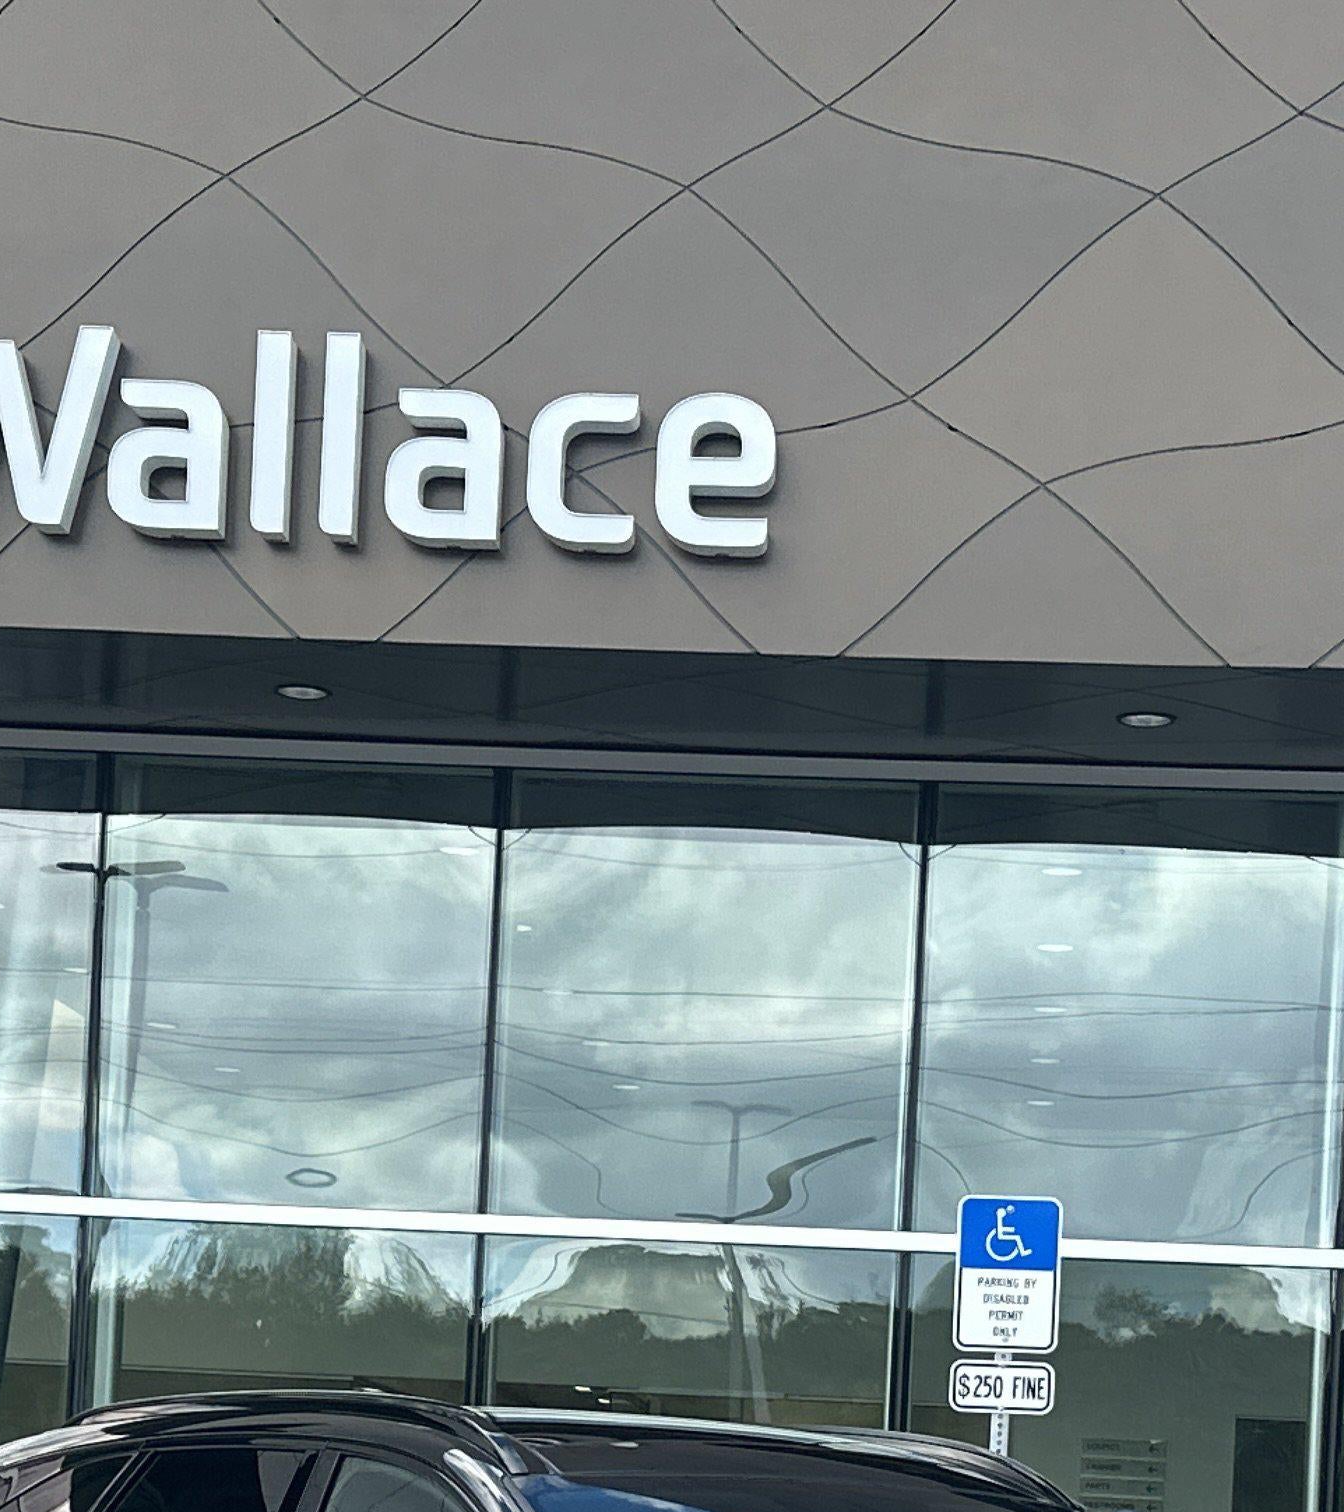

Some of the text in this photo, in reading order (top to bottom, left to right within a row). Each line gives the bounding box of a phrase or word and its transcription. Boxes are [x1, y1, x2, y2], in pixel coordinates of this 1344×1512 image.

[977, 1277, 1037, 1288] PARKING BY
[983, 1295, 1029, 1305] DISABLED
[988, 1310, 1023, 1321] PERMIT
[992, 1327, 1017, 1337] ONLY
[958, 1373, 1045, 1400] $250 FINE
